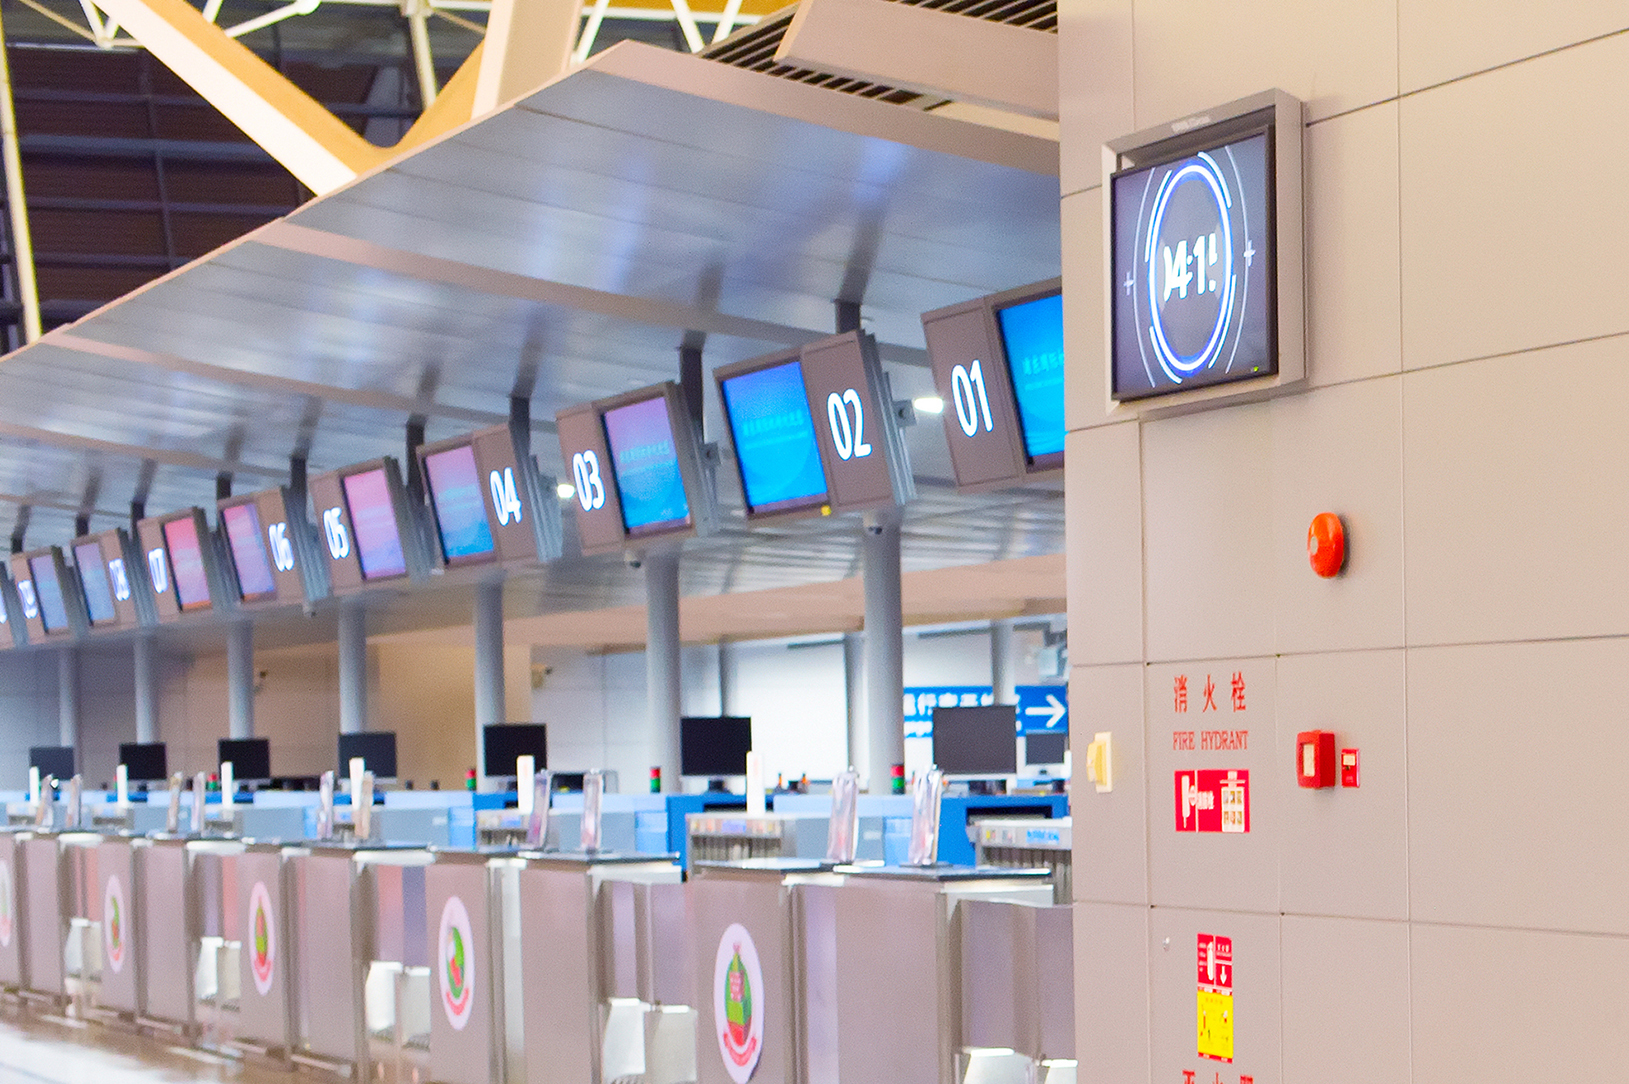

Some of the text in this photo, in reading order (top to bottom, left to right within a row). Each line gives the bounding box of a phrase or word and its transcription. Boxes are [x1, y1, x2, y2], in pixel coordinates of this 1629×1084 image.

[825, 387, 873, 461] 02
[949, 359, 994, 438] 01
[489, 466, 523, 527] 04
[572, 449, 606, 512] 03
[322, 506, 351, 560] 05
[1173, 671, 1247, 713] 消火栓
[1172, 730, 1249, 751] FIRE HYDRANT
